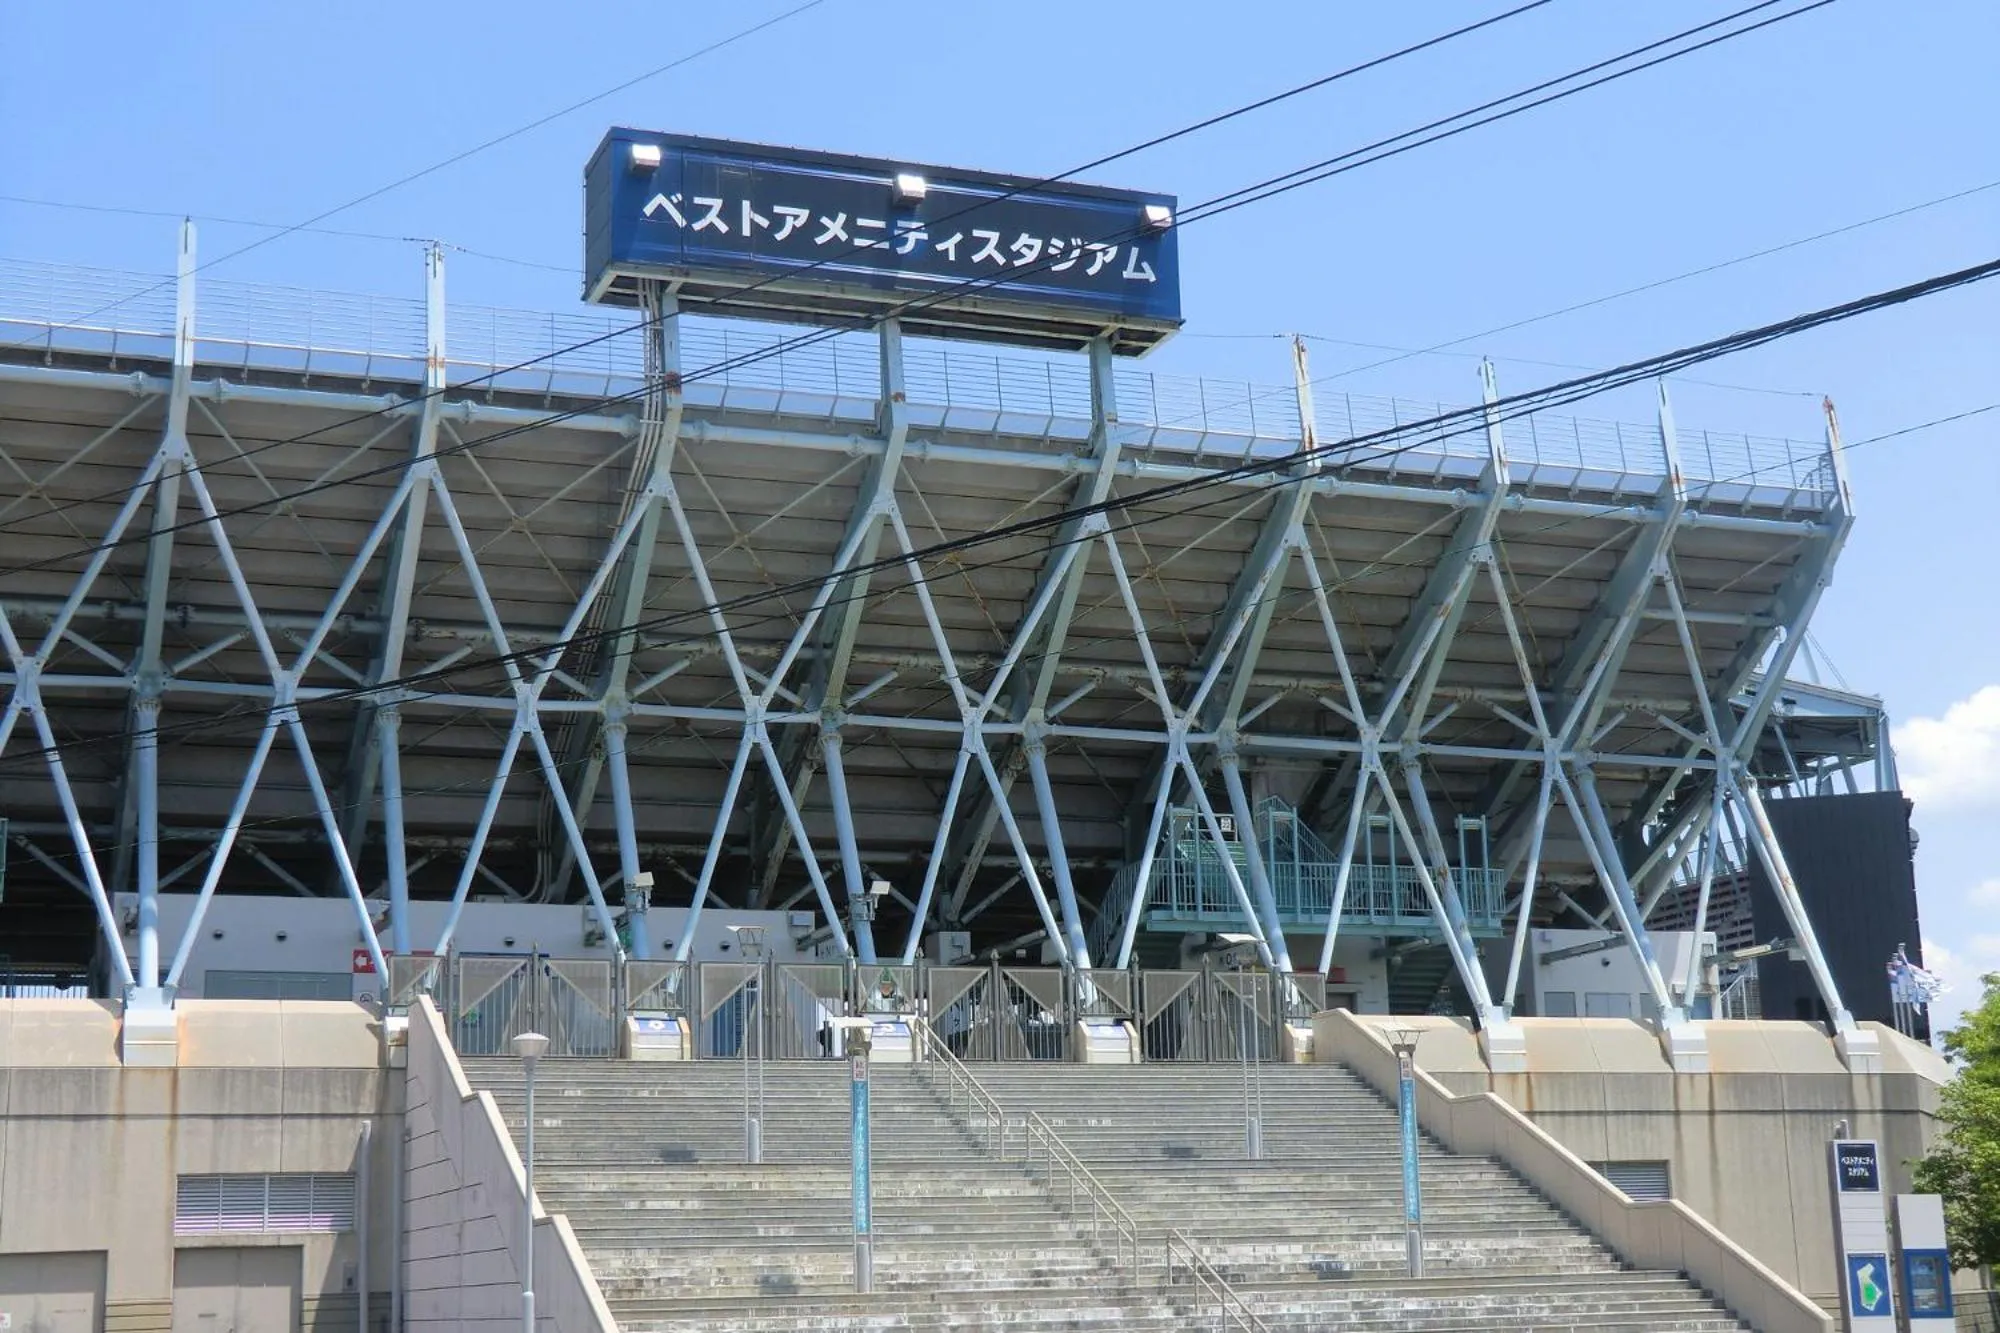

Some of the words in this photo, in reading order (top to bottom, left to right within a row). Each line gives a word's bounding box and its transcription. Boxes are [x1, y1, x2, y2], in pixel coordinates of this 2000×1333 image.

[642, 192, 1157, 283] ベストアメニティスタジアム
